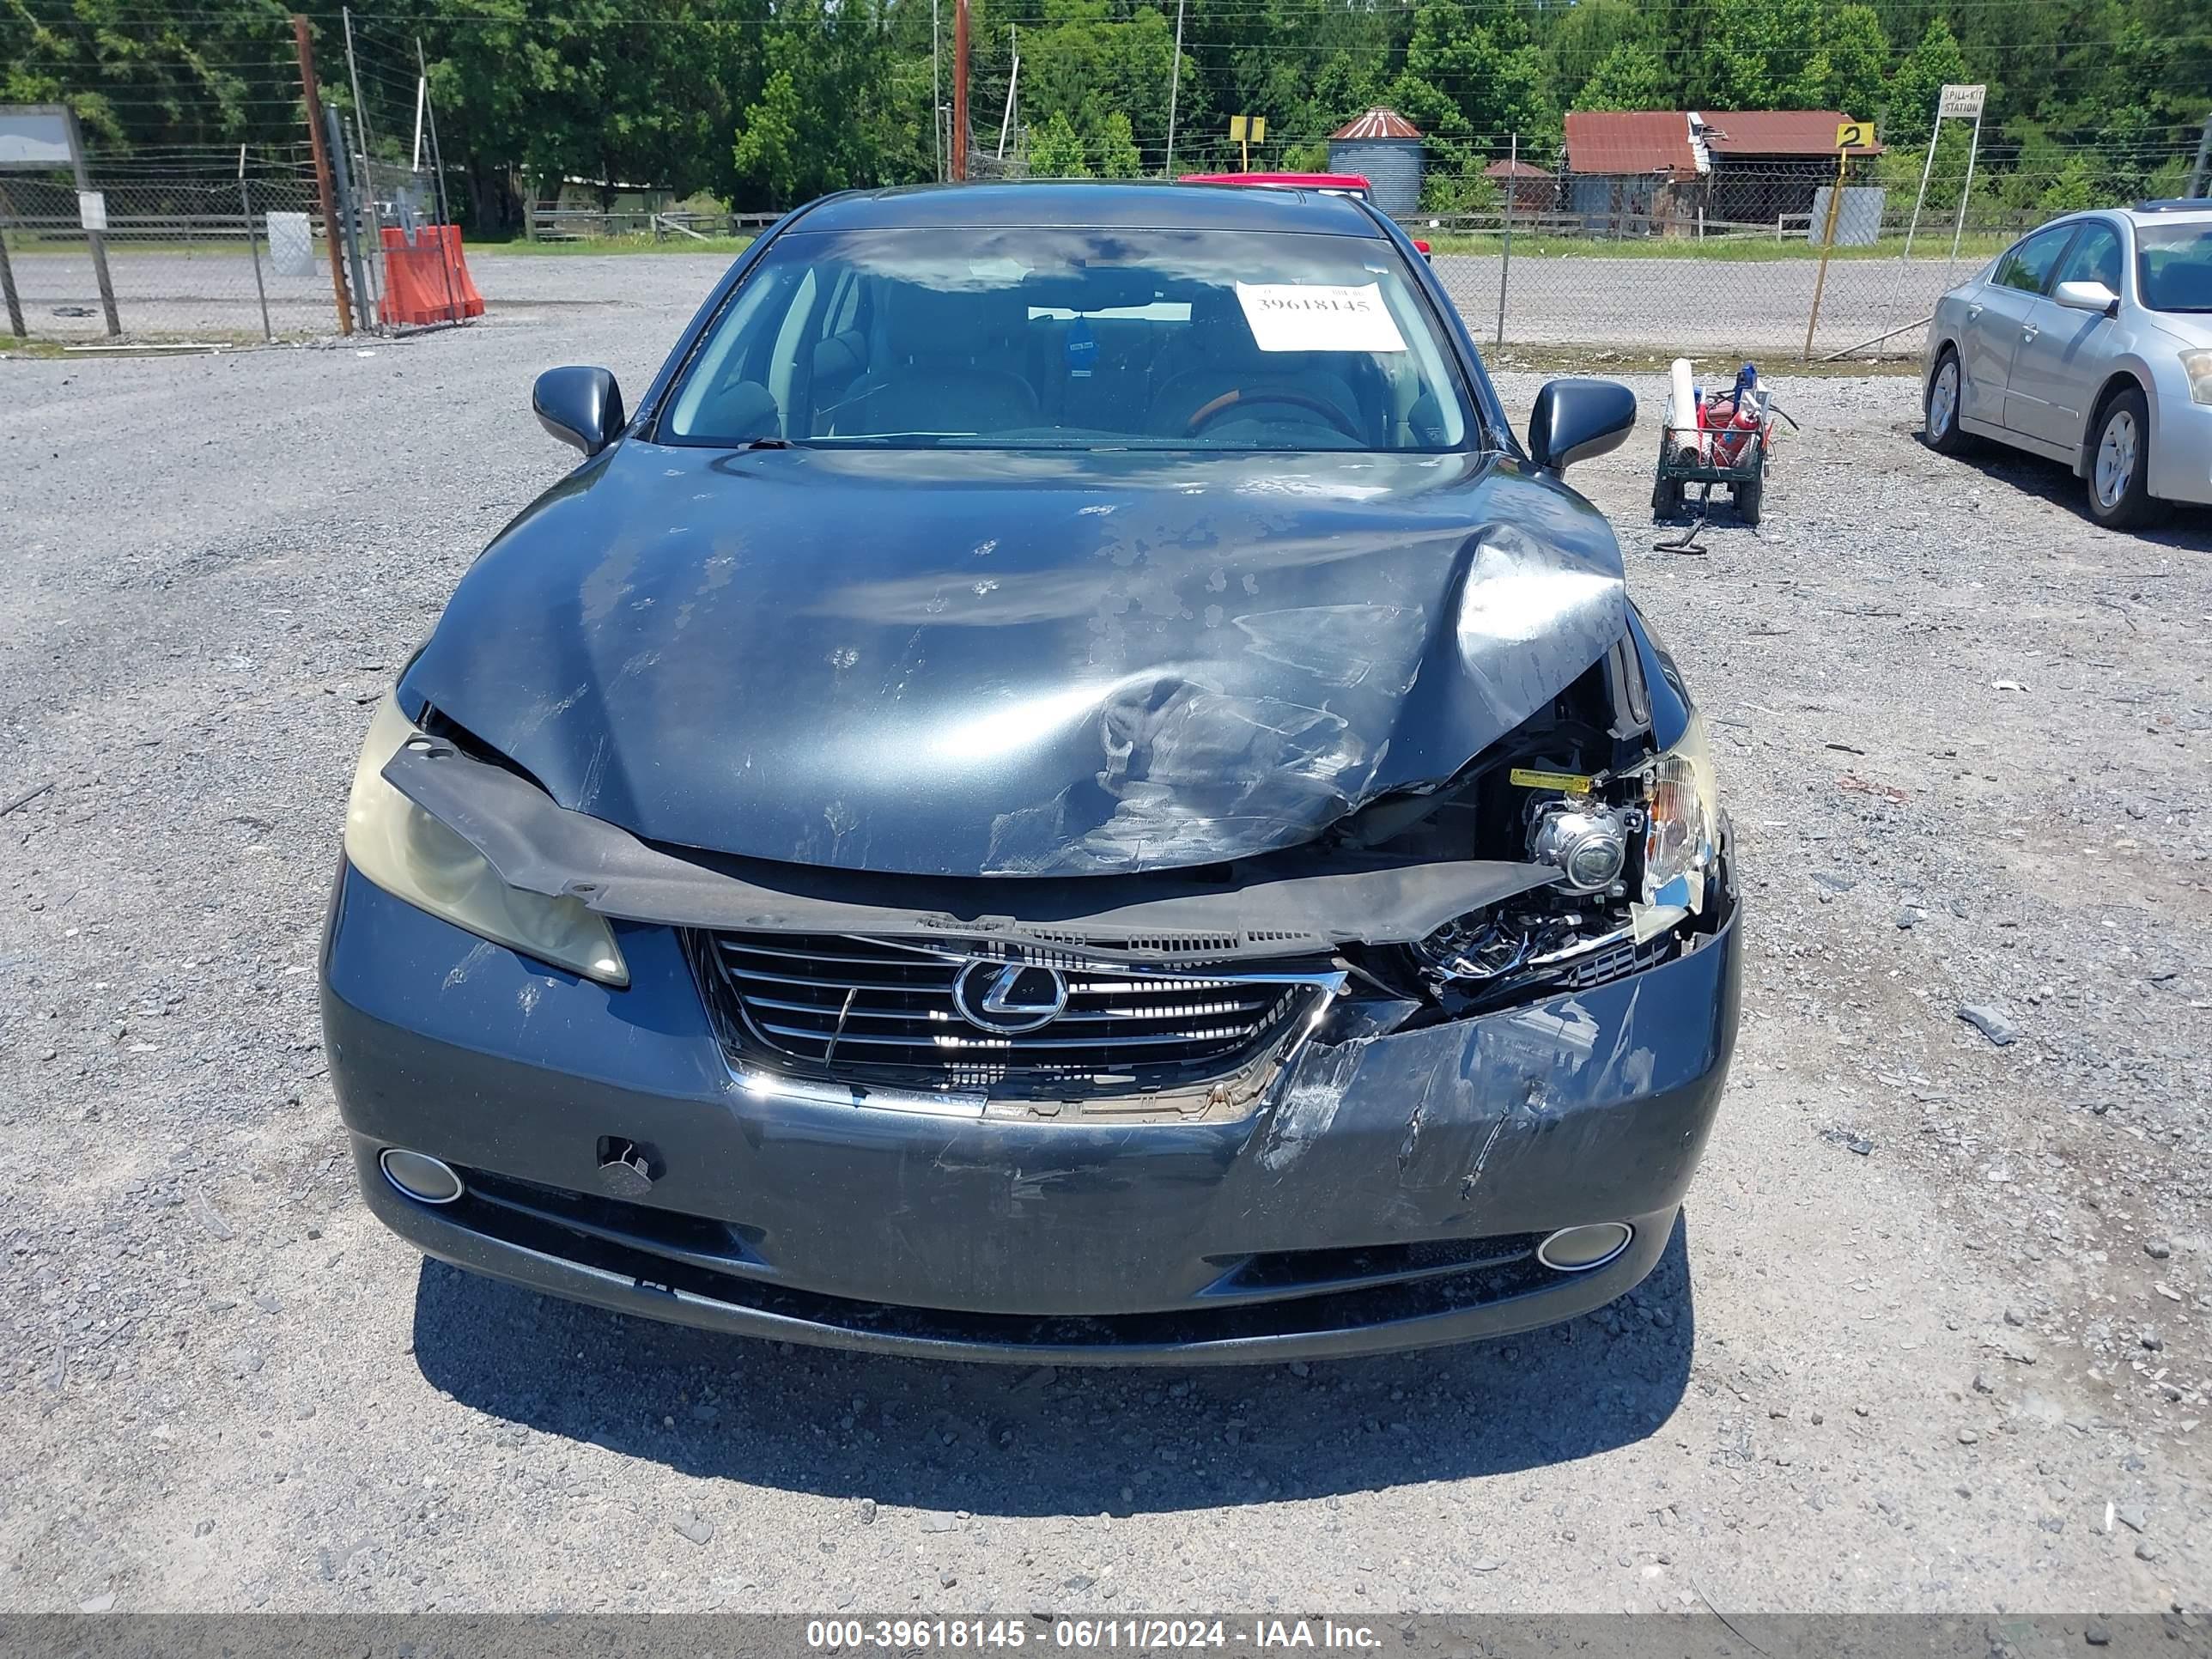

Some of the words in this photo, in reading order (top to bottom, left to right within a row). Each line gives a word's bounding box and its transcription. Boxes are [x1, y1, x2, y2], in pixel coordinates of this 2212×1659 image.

[1944, 102, 1978, 112] STATION
[1838, 125, 1865, 148] 2
[1257, 299, 1370, 312] 39618145
